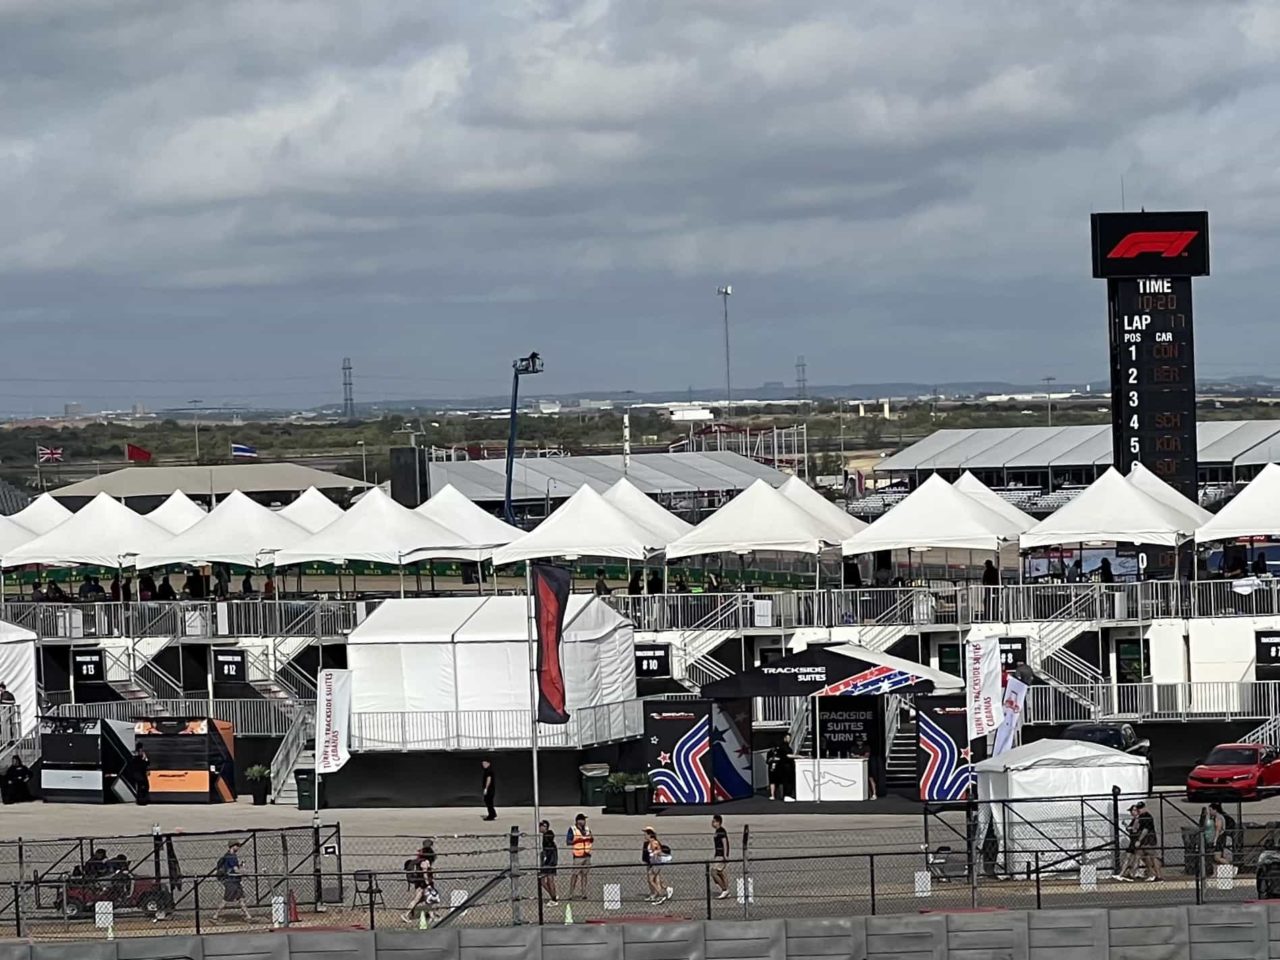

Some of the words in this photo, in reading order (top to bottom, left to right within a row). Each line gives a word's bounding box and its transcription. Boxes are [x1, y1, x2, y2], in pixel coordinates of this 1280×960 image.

[1137, 278, 1172, 293] TIME
[1124, 314, 1151, 330] LAP
[1124, 332, 1142, 343] POS
[1155, 332, 1173, 342] CAR
[1128, 344, 1136, 361] 1
[1128, 367, 1138, 384] 2
[1129, 390, 1139, 407] 3
[1130, 414, 1139, 430] 4
[1130, 437, 1140, 453] 5
[972, 642, 982, 664] SUITES
[762, 666, 826, 674] TRACKSIDE
[797, 674, 827, 682] SUITES
[324, 672, 333, 697] SUITES
[972, 668, 982, 703] TRACKSIDE
[325, 697, 333, 737] TRACKSIDE
[819, 711, 873, 720] TRACKSIDE
[826, 721, 865, 731] SUITES
[974, 714, 985, 736] TURN
[823, 733, 854, 742] TURN
[322, 749, 332, 769] TURN
